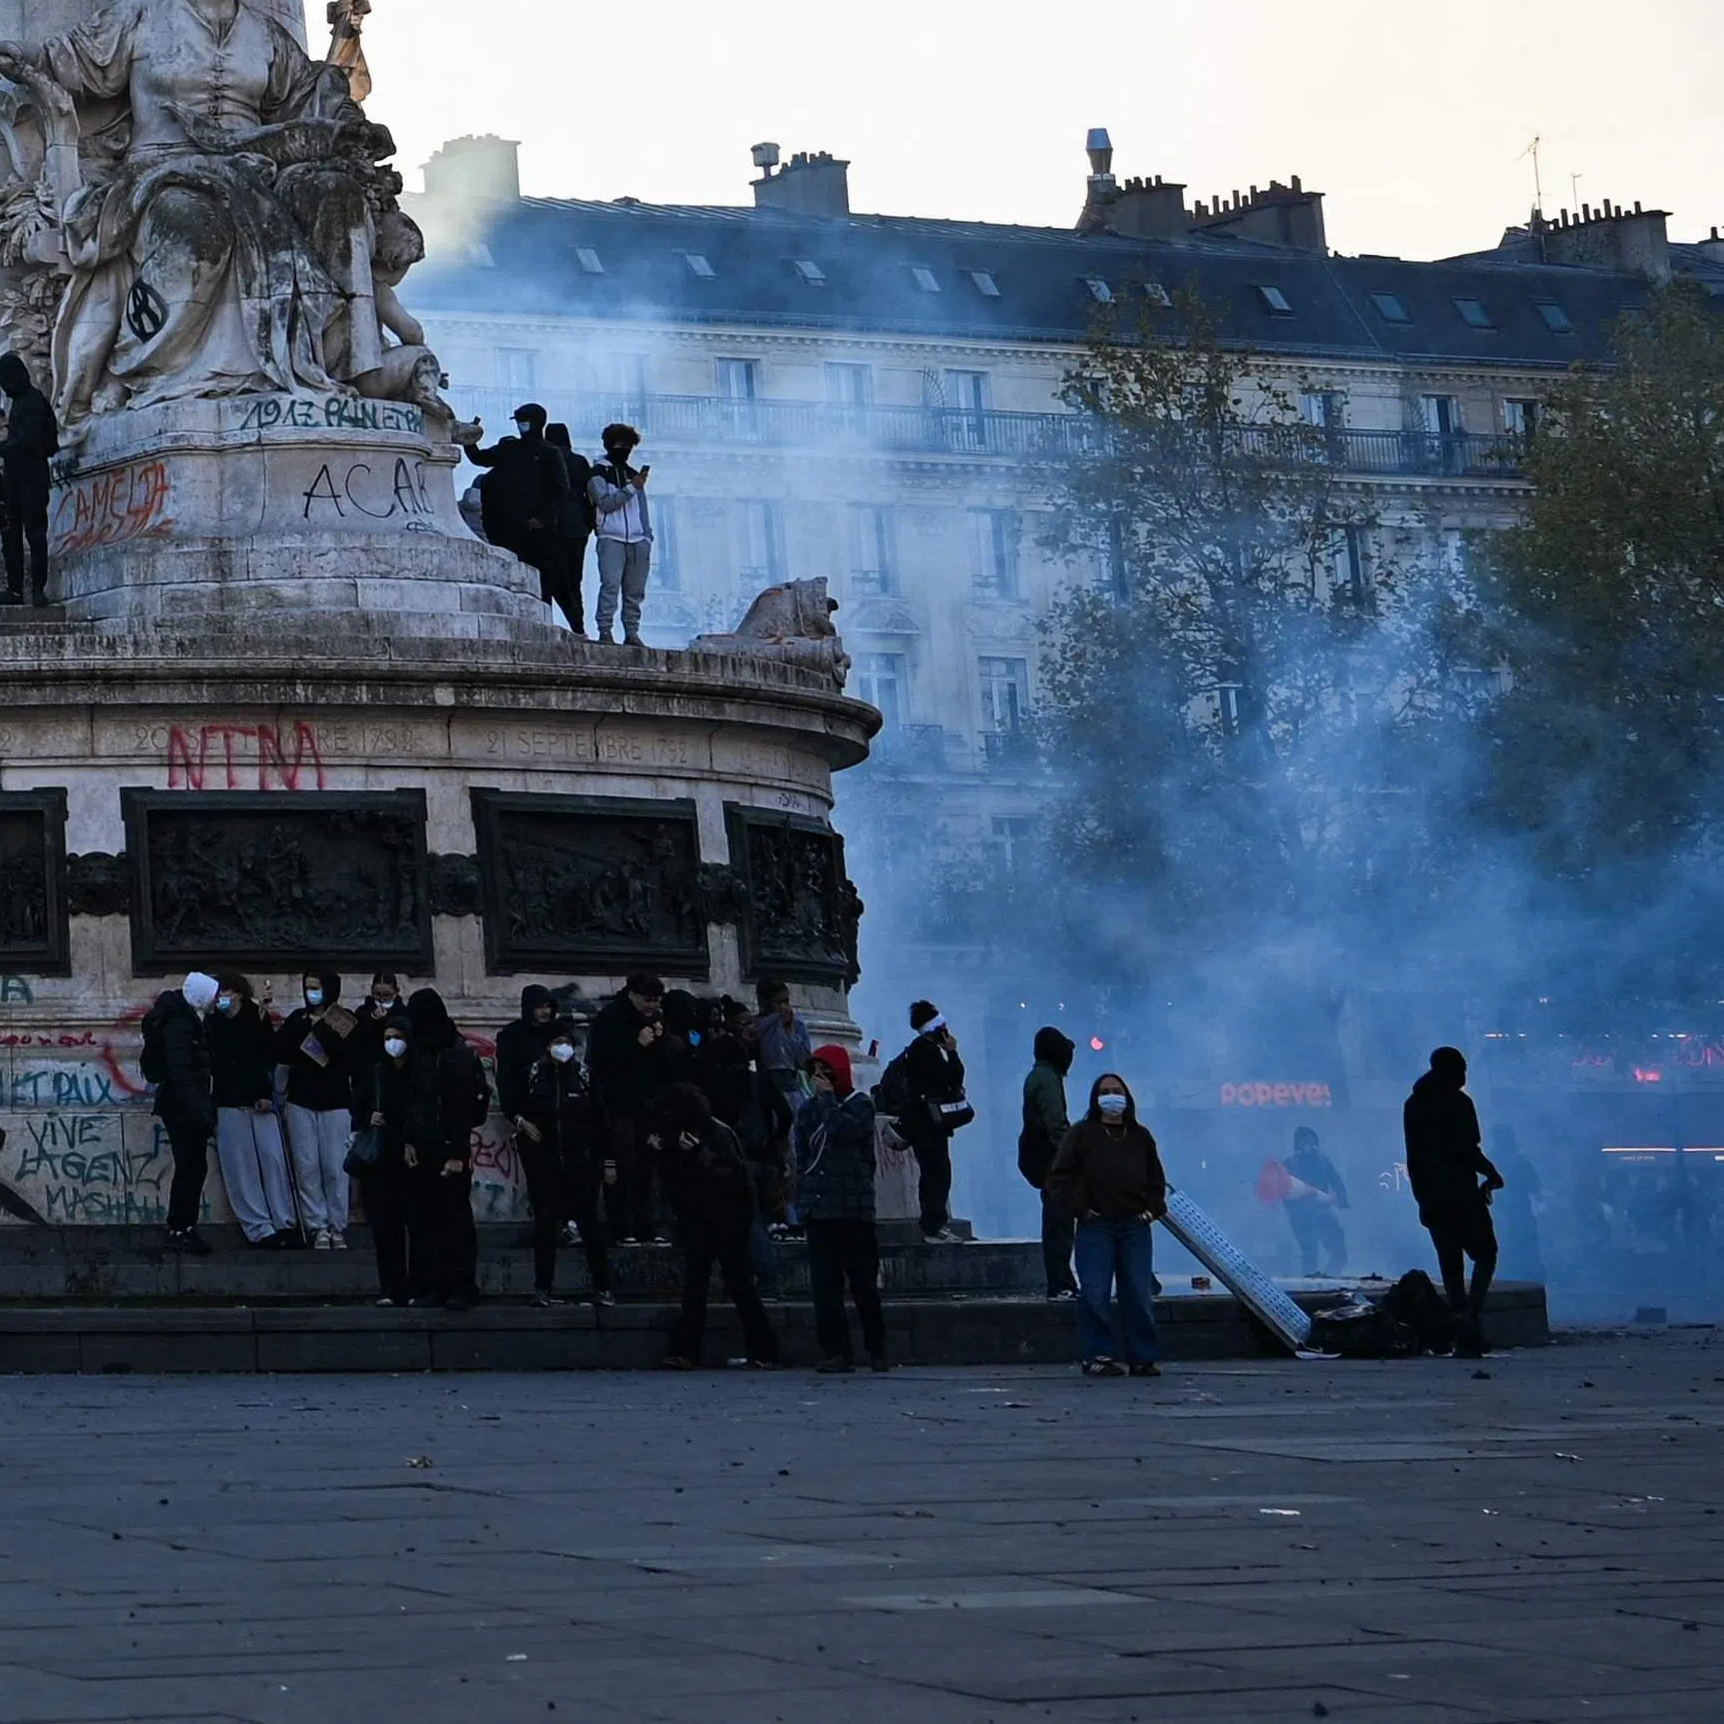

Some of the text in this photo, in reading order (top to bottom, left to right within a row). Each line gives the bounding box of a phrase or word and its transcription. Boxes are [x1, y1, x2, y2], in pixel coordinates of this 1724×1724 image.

[239, 398, 320, 431] 1917
[324, 397, 380, 430] PAIN
[383, 405, 402, 431] ET
[486, 730, 506, 754] 21
[517, 731, 642, 761] SEPTEMBRE
[25, 1114, 111, 1149] VIVE
